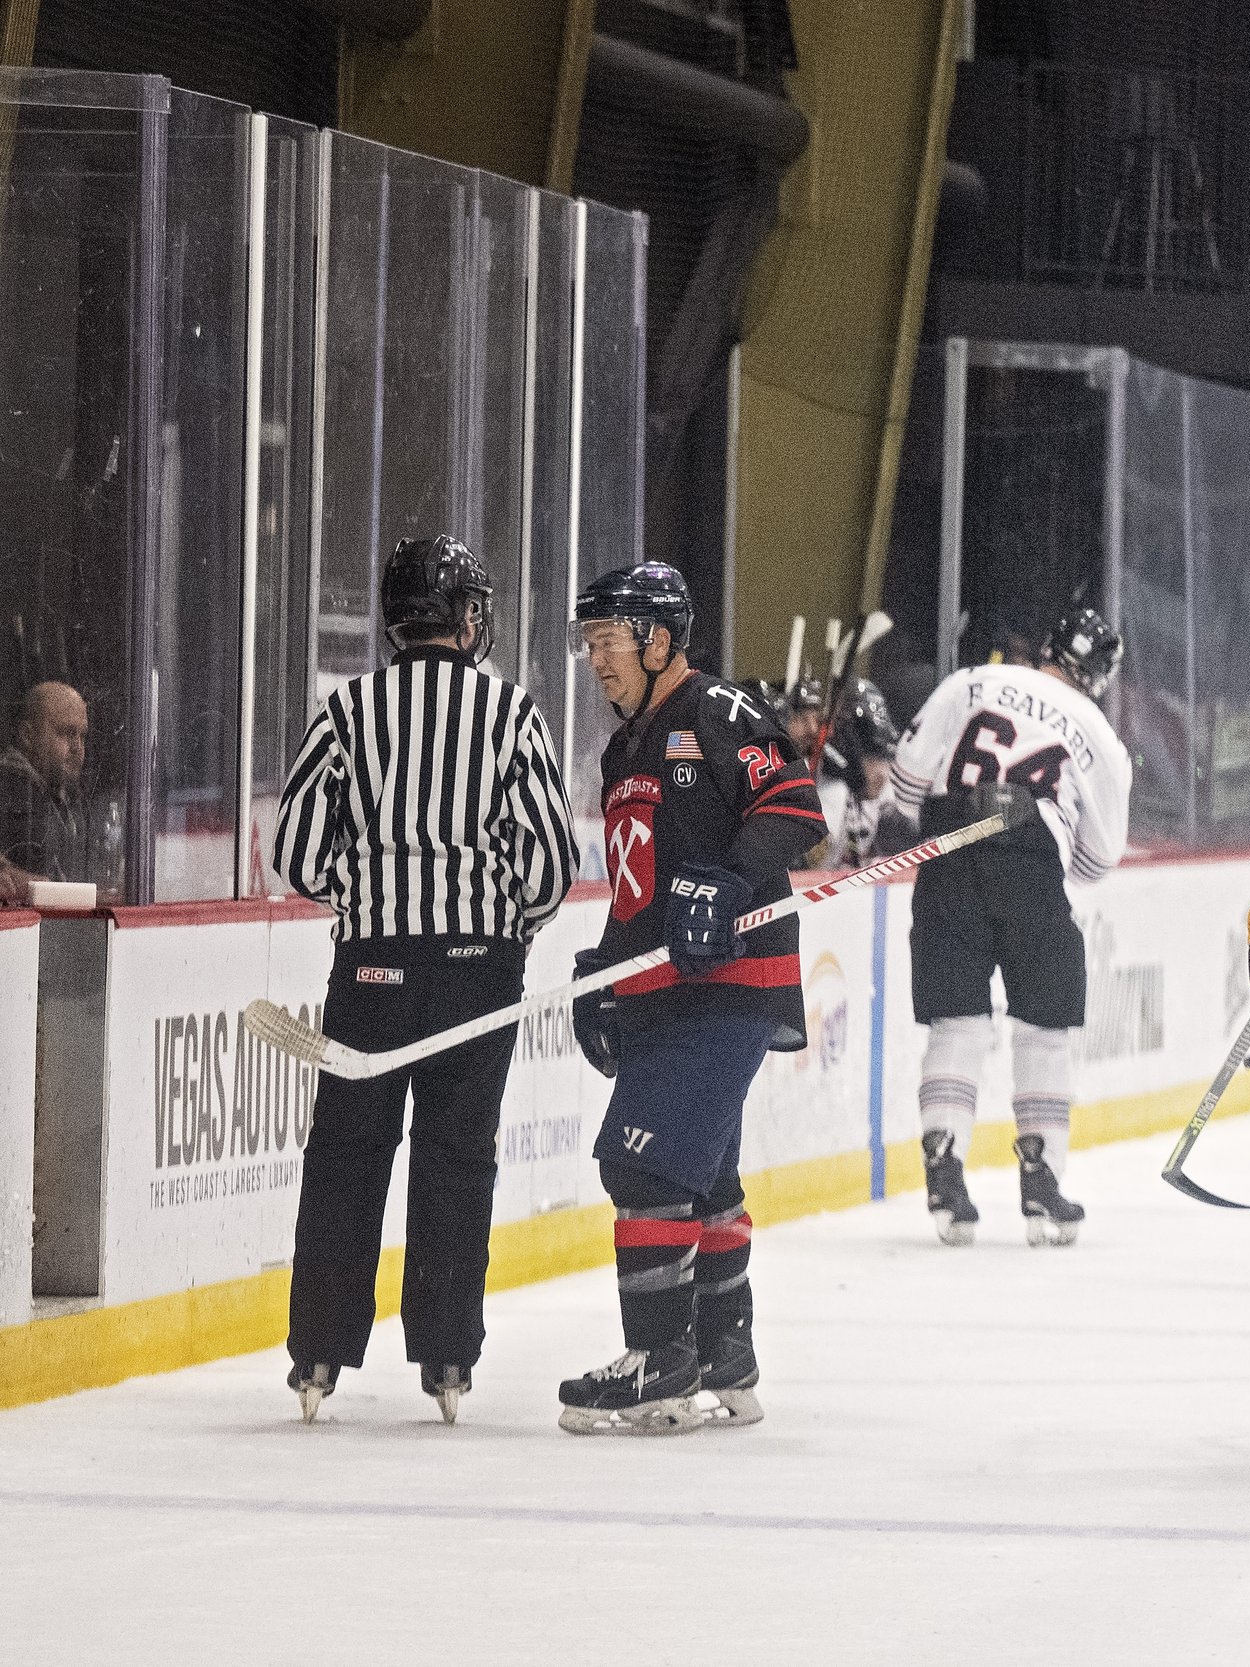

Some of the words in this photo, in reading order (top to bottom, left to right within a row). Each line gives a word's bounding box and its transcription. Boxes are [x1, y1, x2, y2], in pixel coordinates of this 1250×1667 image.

[947, 709, 1071, 804] 64
[998, 686, 1094, 772] SAVARD
[677, 766, 693, 784] CV
[738, 741, 786, 790] 24
[359, 969, 401, 983] CCM
[523, 1000, 573, 1062] NATION
[155, 1010, 228, 1169] VEGAS
[230, 1004, 291, 1158] AUTO
[150, 1180, 165, 1210] THE
[168, 1176, 191, 1206] WEST
[194, 1170, 228, 1202] COAST'S
[230, 1164, 266, 1195] LARGEST
[269, 1158, 300, 1190] LUXURY
